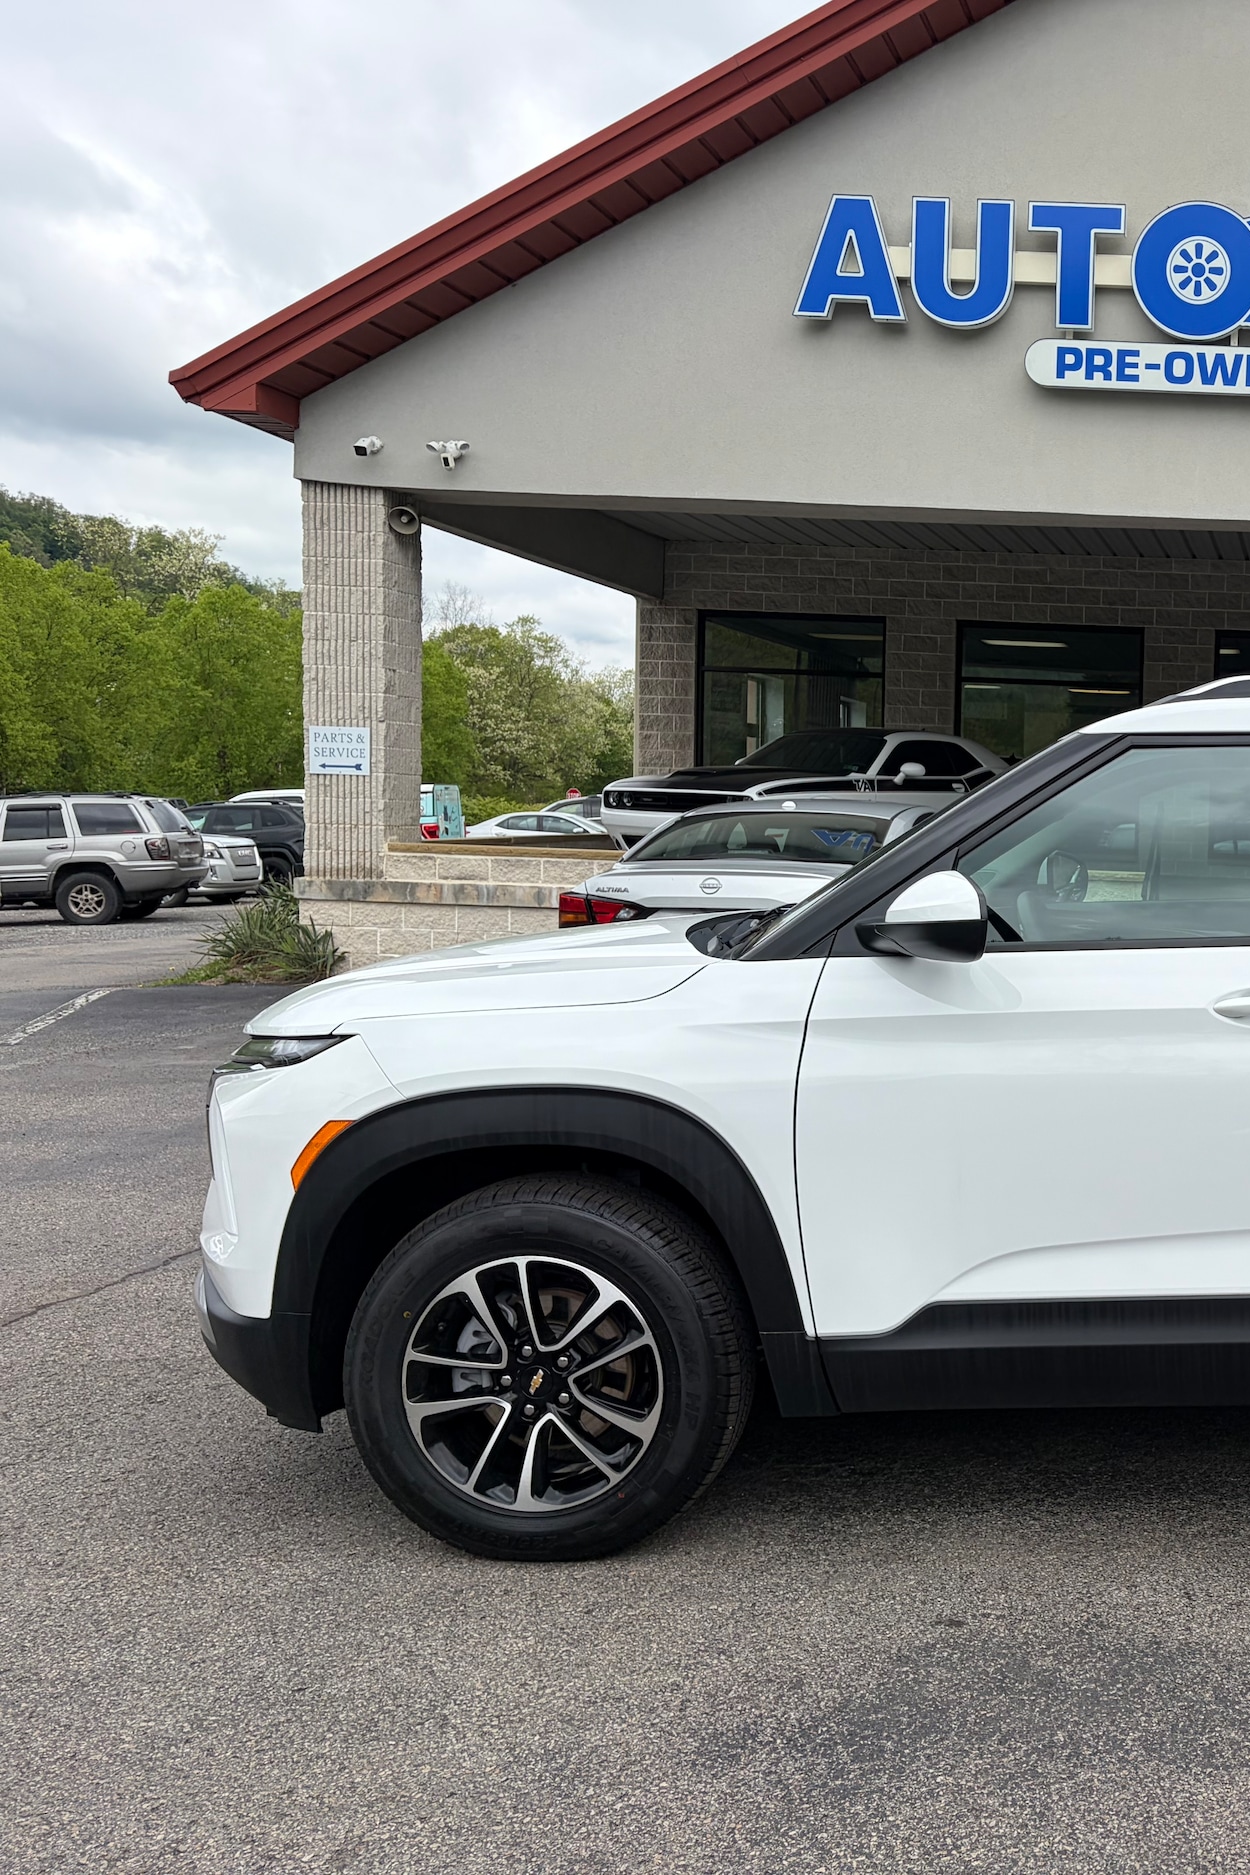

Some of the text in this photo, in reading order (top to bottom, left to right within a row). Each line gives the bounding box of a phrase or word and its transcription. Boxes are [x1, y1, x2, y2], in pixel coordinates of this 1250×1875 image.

[314, 732, 365, 743] PARTS &
[314, 747, 366, 759] SERVICE
